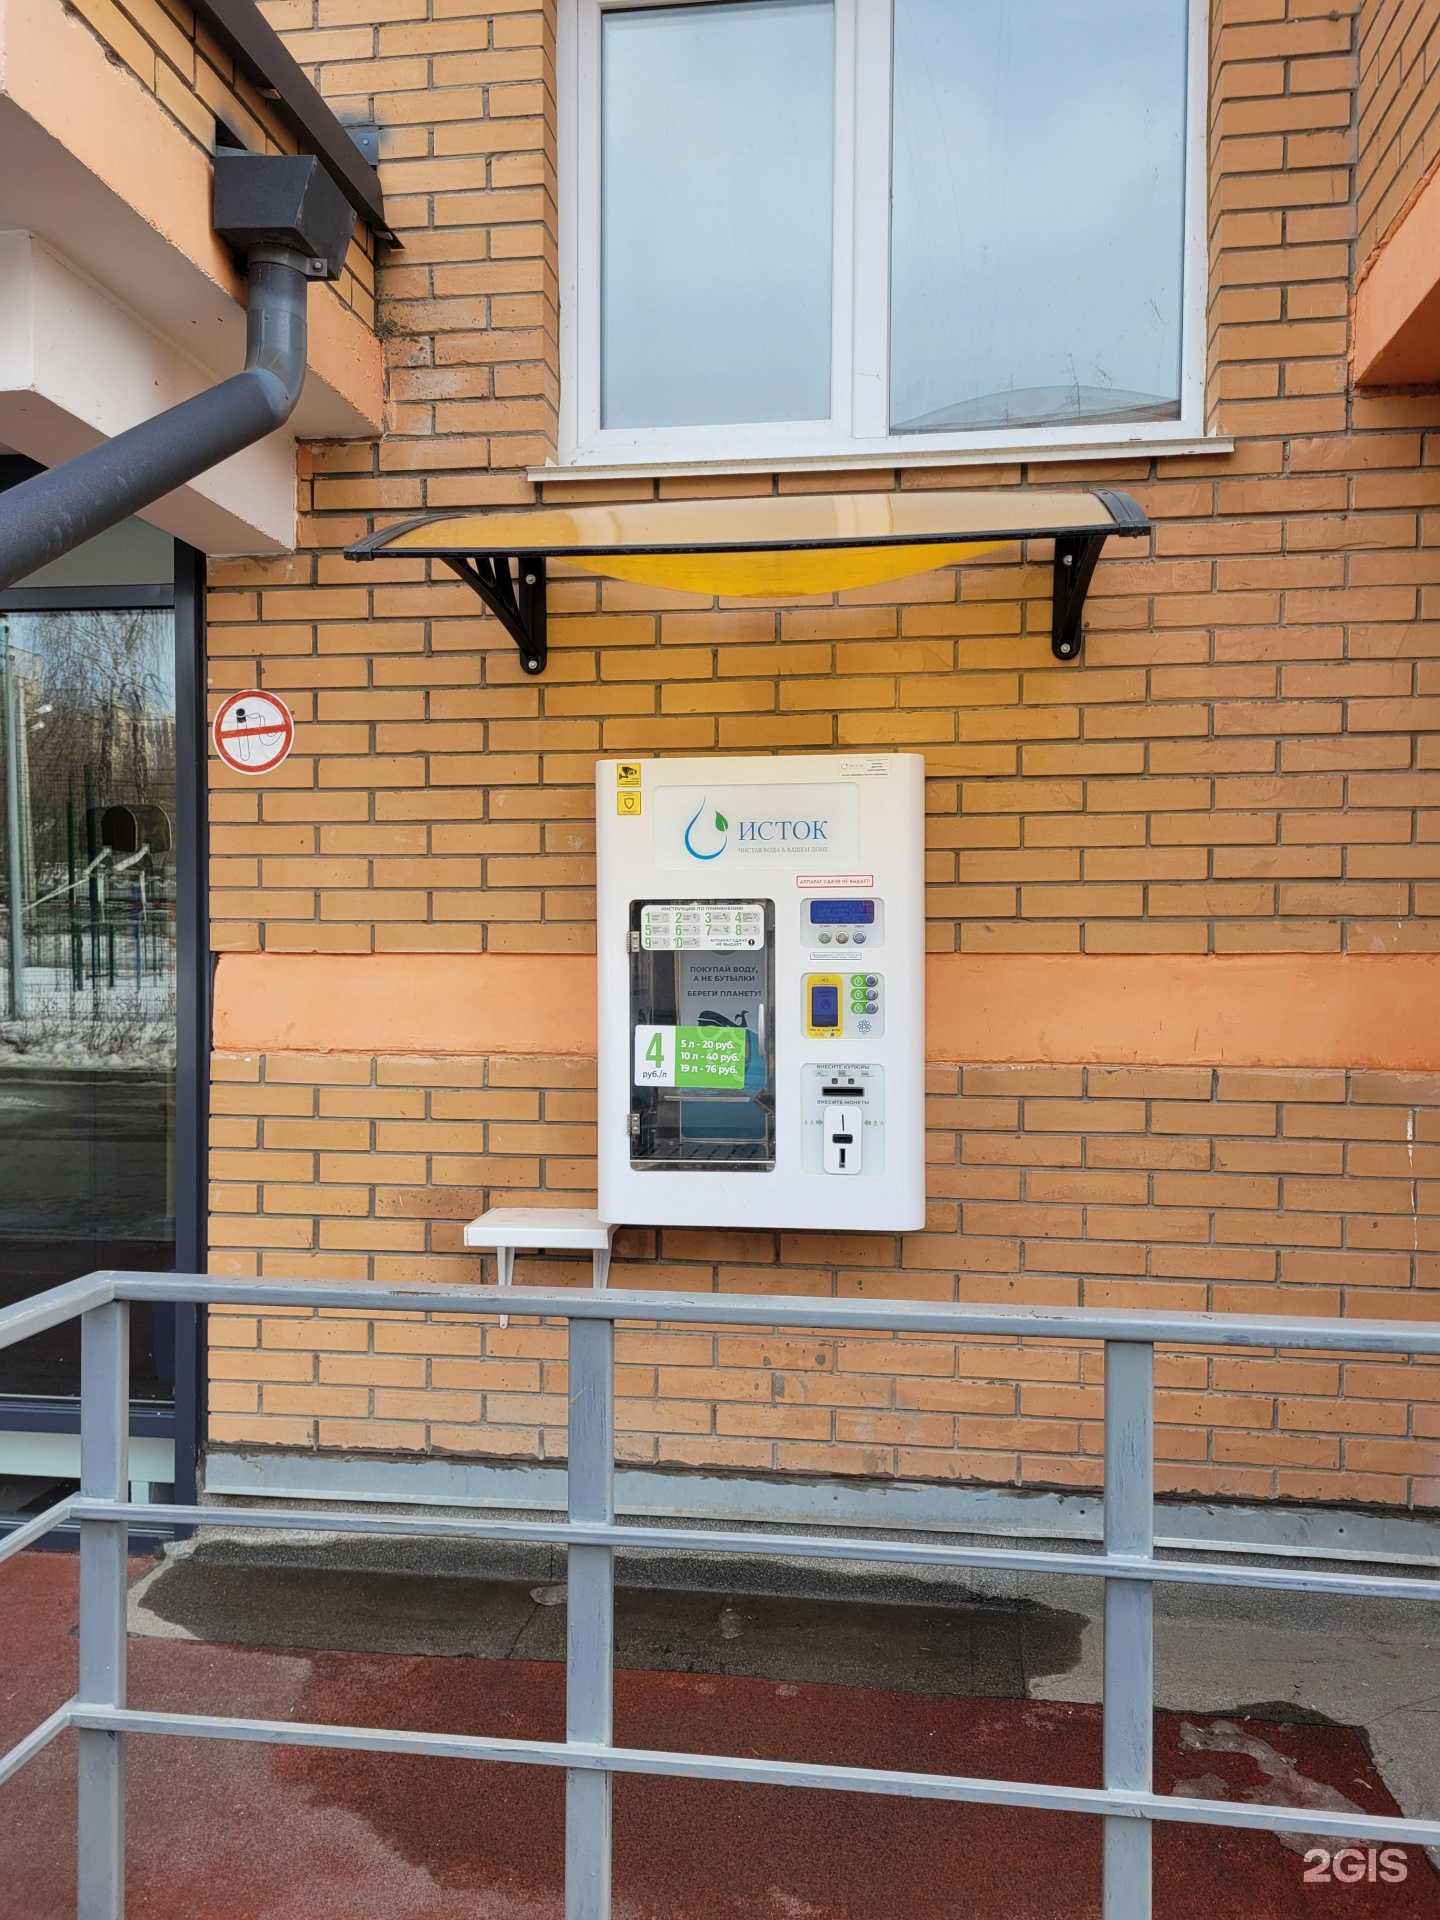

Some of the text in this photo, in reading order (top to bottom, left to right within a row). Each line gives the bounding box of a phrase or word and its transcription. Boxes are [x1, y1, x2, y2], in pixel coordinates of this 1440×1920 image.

[738, 820, 828, 841] ИСТОК
[645, 912, 651, 923] 1
[675, 912, 682, 923] 2
[705, 912, 712, 923] 3
[735, 912, 742, 923] 4
[644, 925, 652, 936] 5
[675, 925, 682, 936] 6
[705, 925, 712, 936] 7
[735, 925, 742, 936] 8
[644, 937, 652, 948] 9
[673, 937, 683, 948] 10
[690, 965, 759, 974] ПОКУПАЙ ВОДУ,
[645, 1032, 665, 1069] 4
[715, 1040, 736, 1052] руб.
[680, 1052, 691, 1060] 10
[706, 1053, 719, 1061] 40
[720, 1053, 740, 1063] руб.
[642, 1069, 668, 1079] руб./л
[705, 1065, 717, 1073] 76
[718, 1065, 738, 1075] руб.
